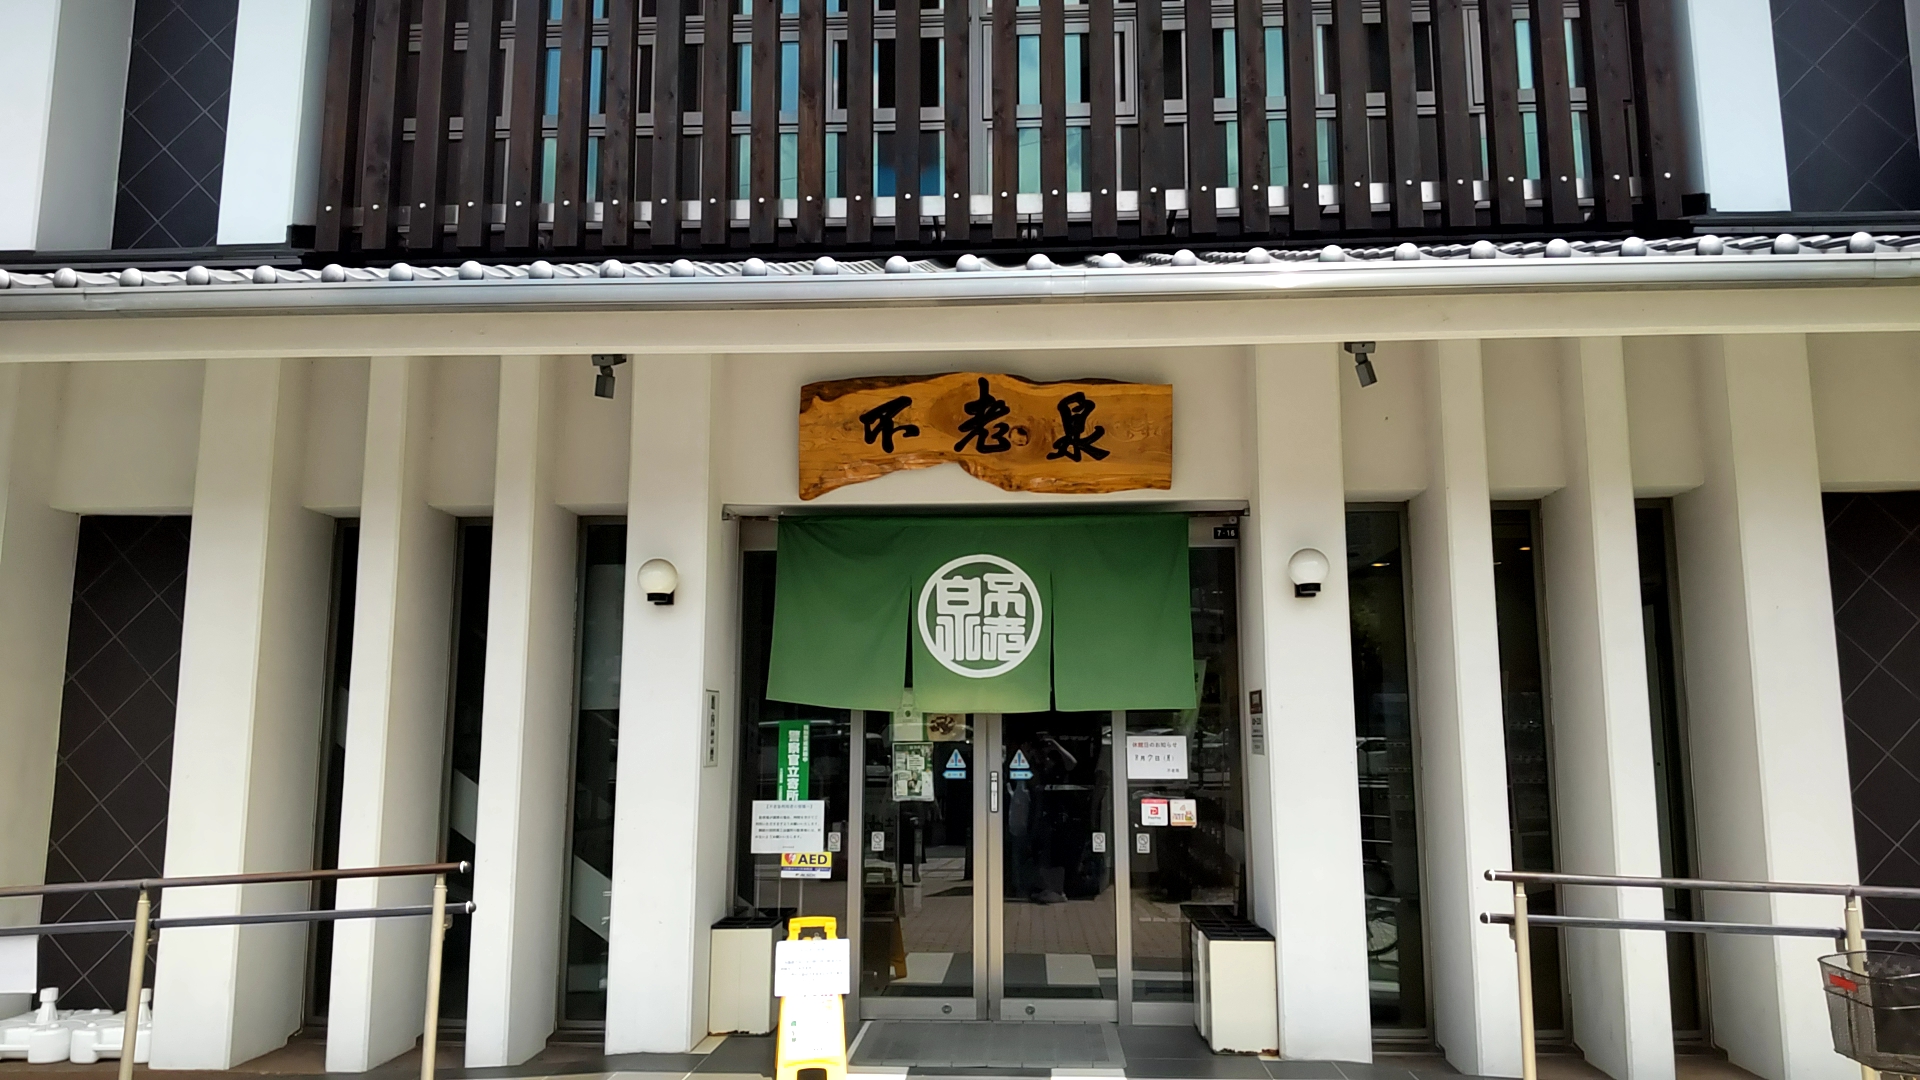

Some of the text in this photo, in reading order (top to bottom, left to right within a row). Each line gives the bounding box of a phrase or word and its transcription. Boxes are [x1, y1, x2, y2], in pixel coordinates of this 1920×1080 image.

[859, 377, 1111, 462] 不老泉
[1216, 529, 1236, 537] 7-16
[1132, 741, 1178, 749] 休館日のお知らせ
[797, 854, 828, 865] AED
